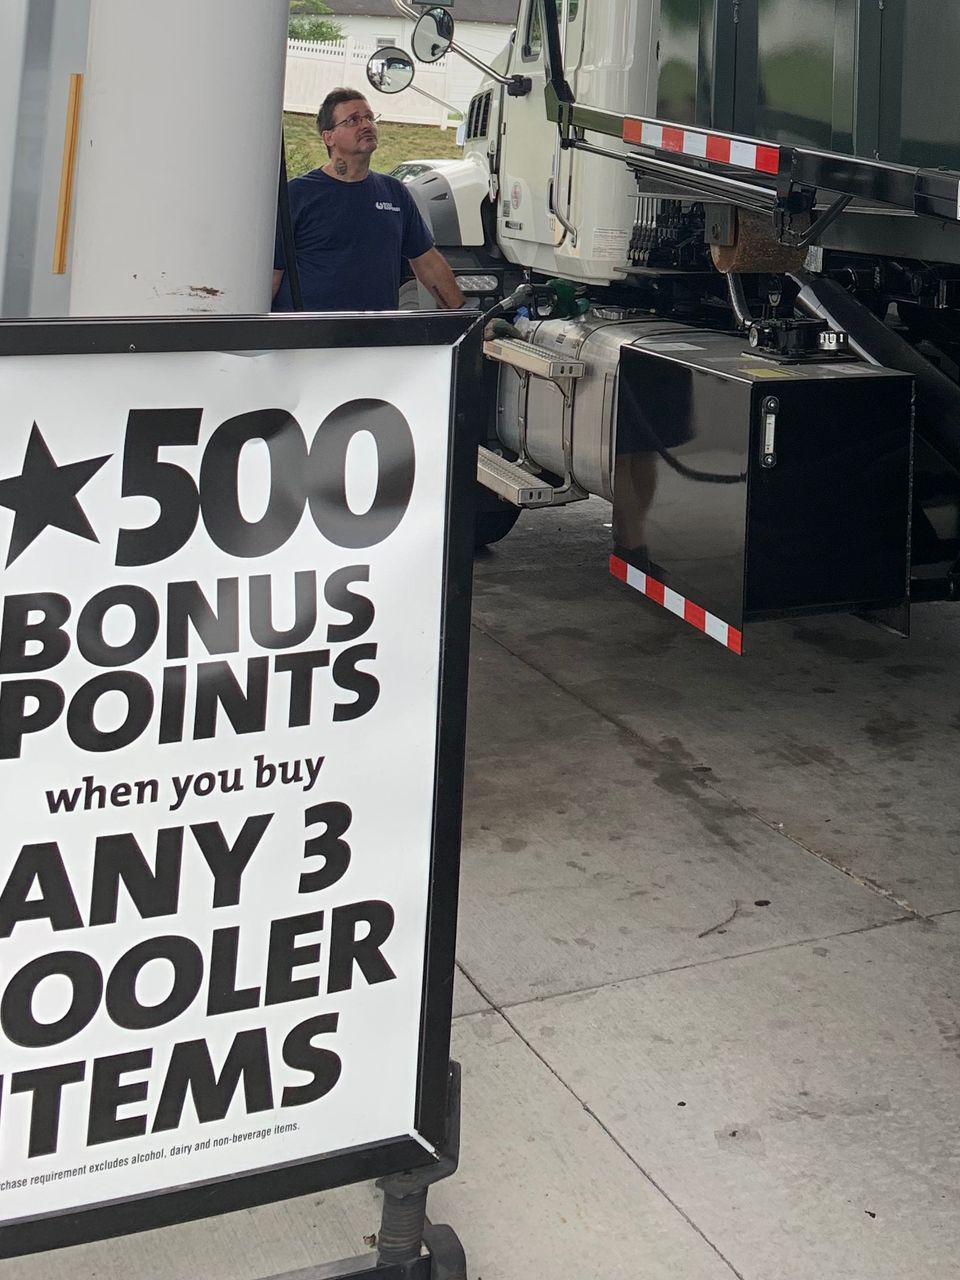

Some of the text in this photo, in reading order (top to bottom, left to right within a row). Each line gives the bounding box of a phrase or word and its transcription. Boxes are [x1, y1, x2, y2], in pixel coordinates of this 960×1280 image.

[115, 397, 415, 567] 500
[0, 565, 376, 674] BONUS
[0, 642, 380, 760] POINTS
[45, 755, 325, 814] when you buy
[0, 800, 352, 939] ANY 3
[0, 899, 397, 1049] OOLER
[0, 1011, 342, 1159] TEMS
[30, 1164, 87, 1186] requirement
[89, 1156, 129, 1174] excludes
[170, 1143, 192, 1156] dairy
[194, 1138, 211, 1152] and
[213, 1127, 271, 1148] non-beverage
[274, 1122, 300, 1135] items.
